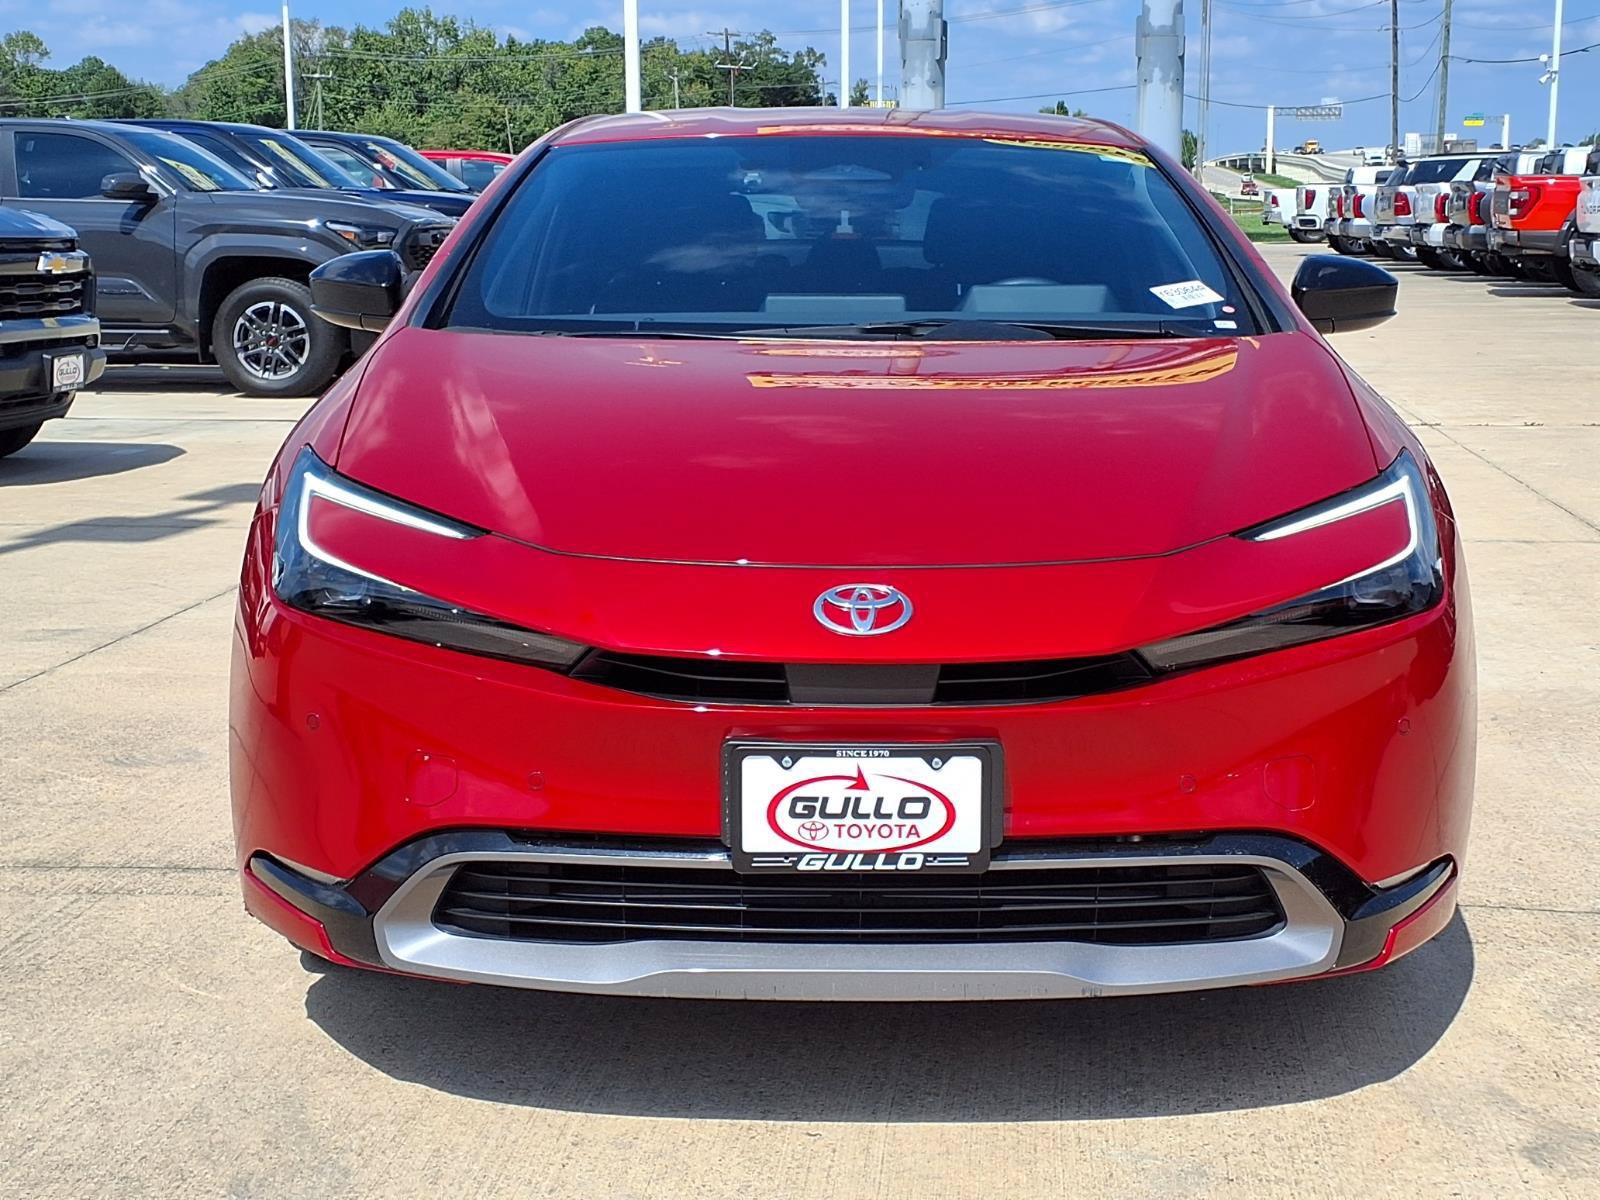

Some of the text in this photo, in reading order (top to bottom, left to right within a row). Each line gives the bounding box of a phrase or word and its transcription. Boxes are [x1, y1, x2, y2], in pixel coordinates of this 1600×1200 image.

[836, 750, 890, 758] SINCE 1970
[788, 796, 931, 820] GULLO
[833, 824, 921, 839] TOYOTA
[796, 853, 925, 871] GULLO
